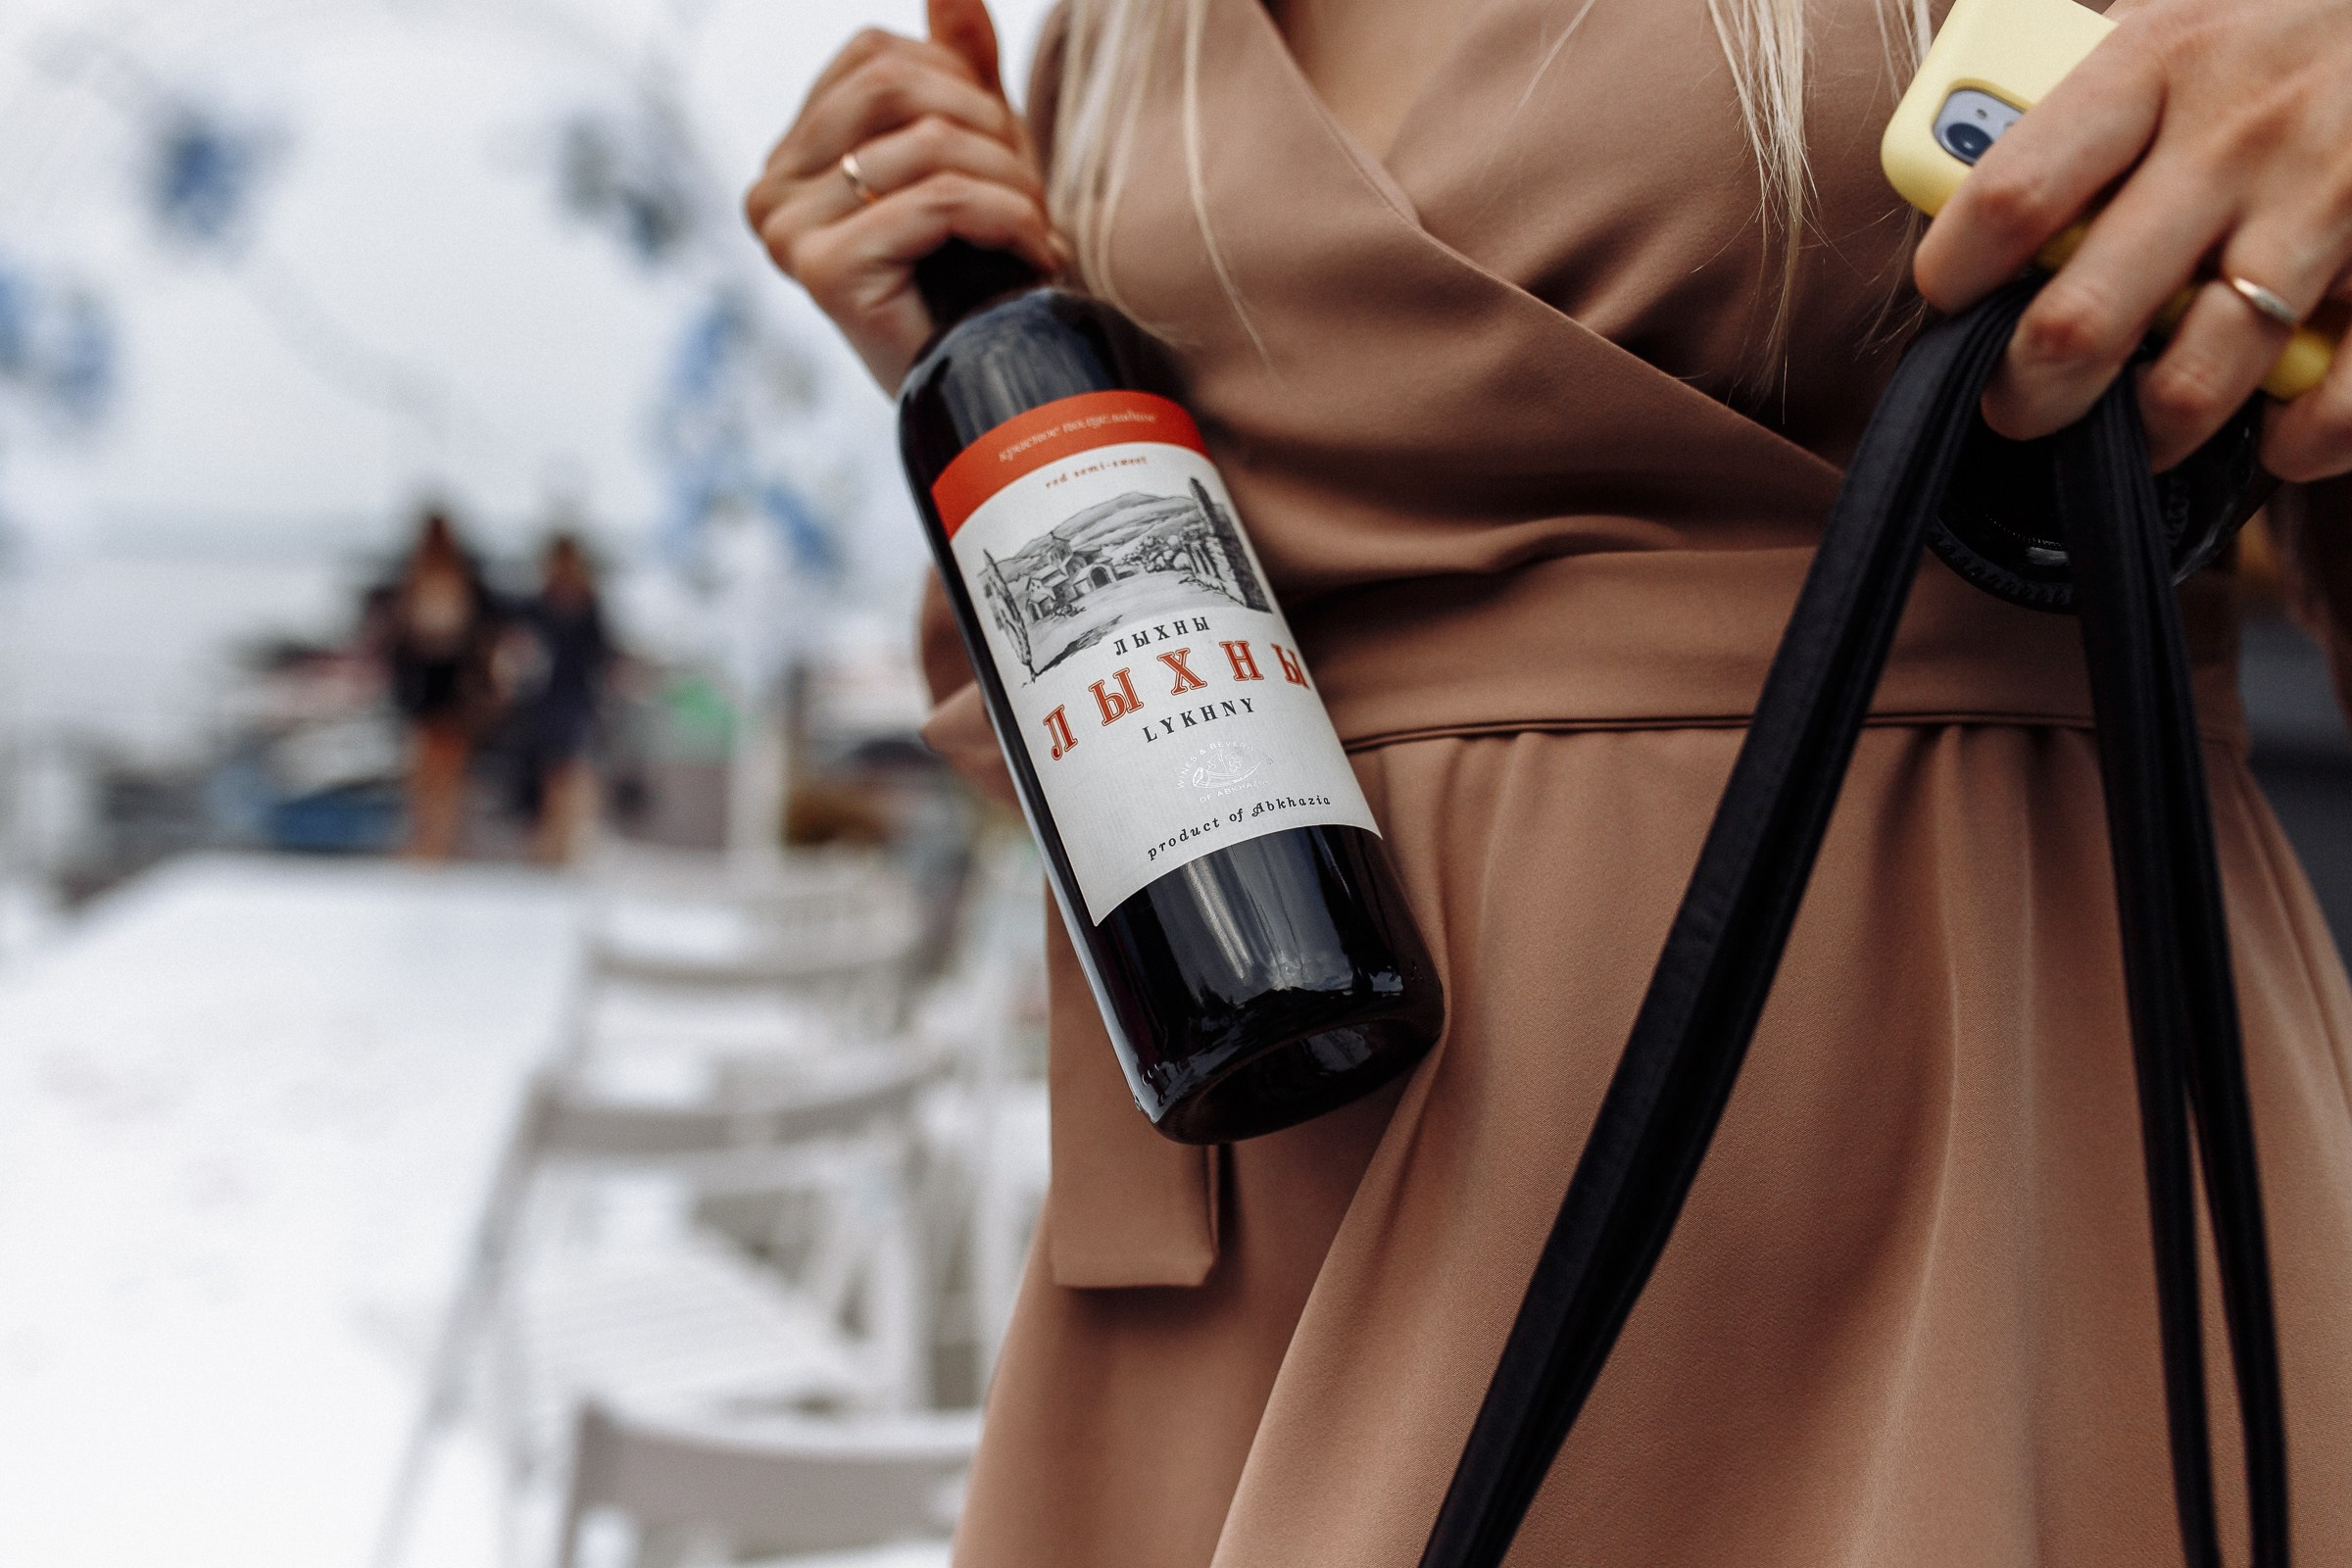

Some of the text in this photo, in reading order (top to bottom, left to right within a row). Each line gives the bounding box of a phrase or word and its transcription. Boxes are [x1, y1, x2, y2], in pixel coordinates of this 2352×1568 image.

[1046, 456, 1148, 489] red semi-sweet
[1113, 616, 1210, 656] ЛЫХНЫ
[1042, 640, 1310, 761] ЛЫХНЫ
[1142, 698, 1255, 744] LYKHNY
[1176, 756, 1198, 789] WINES
[1199, 794, 1213, 804] OF
[1147, 795, 1331, 861] product of Abkhazia
